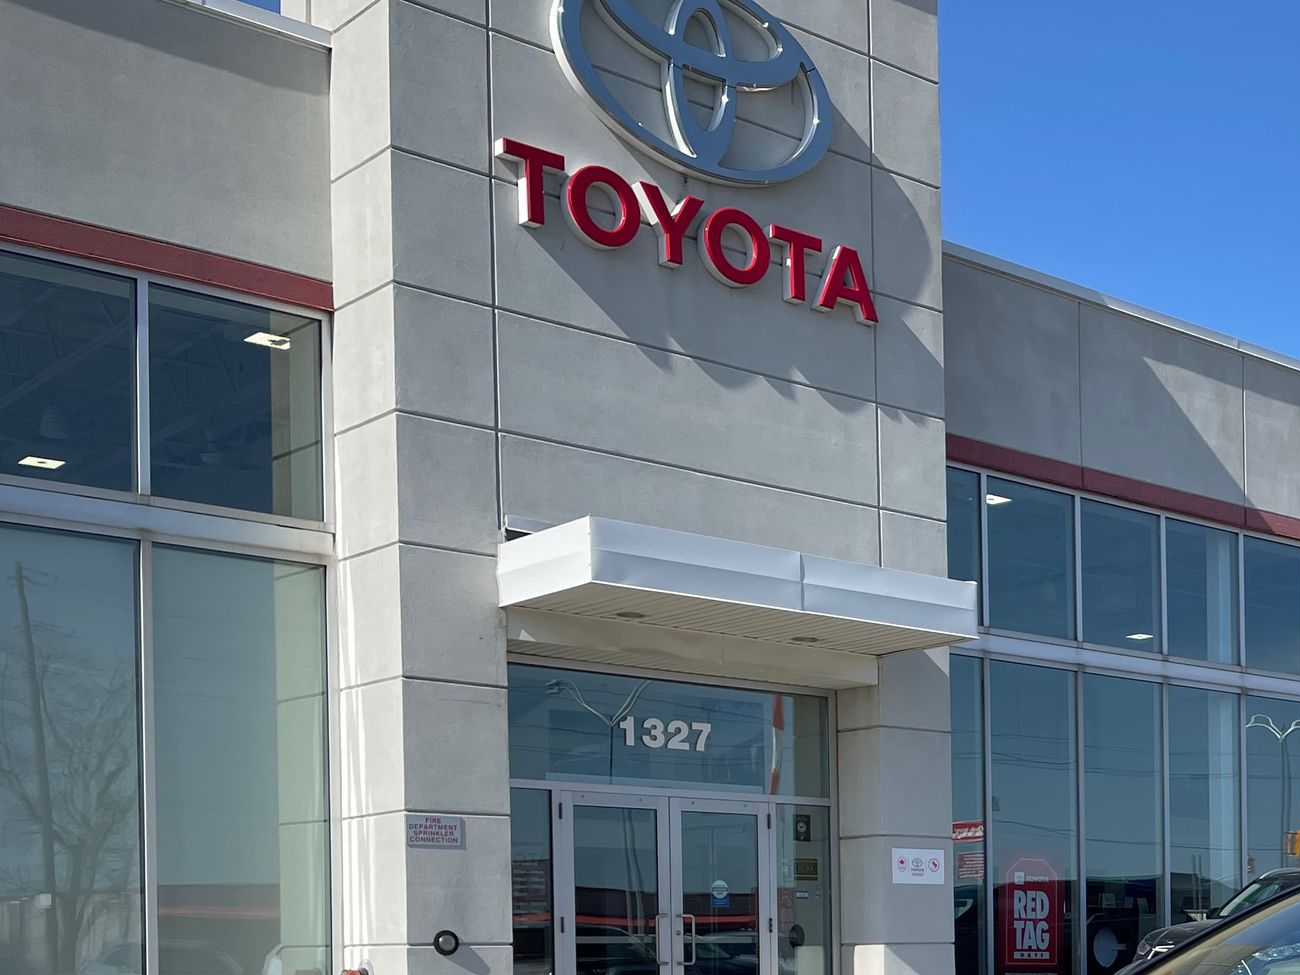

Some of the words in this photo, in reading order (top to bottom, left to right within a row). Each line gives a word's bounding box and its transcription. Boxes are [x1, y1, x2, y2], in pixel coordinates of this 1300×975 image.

[496, 137, 879, 325] TOYOTA
[619, 716, 711, 752] 1327
[1013, 889, 1049, 919] RED
[1013, 920, 1049, 950] TAG
